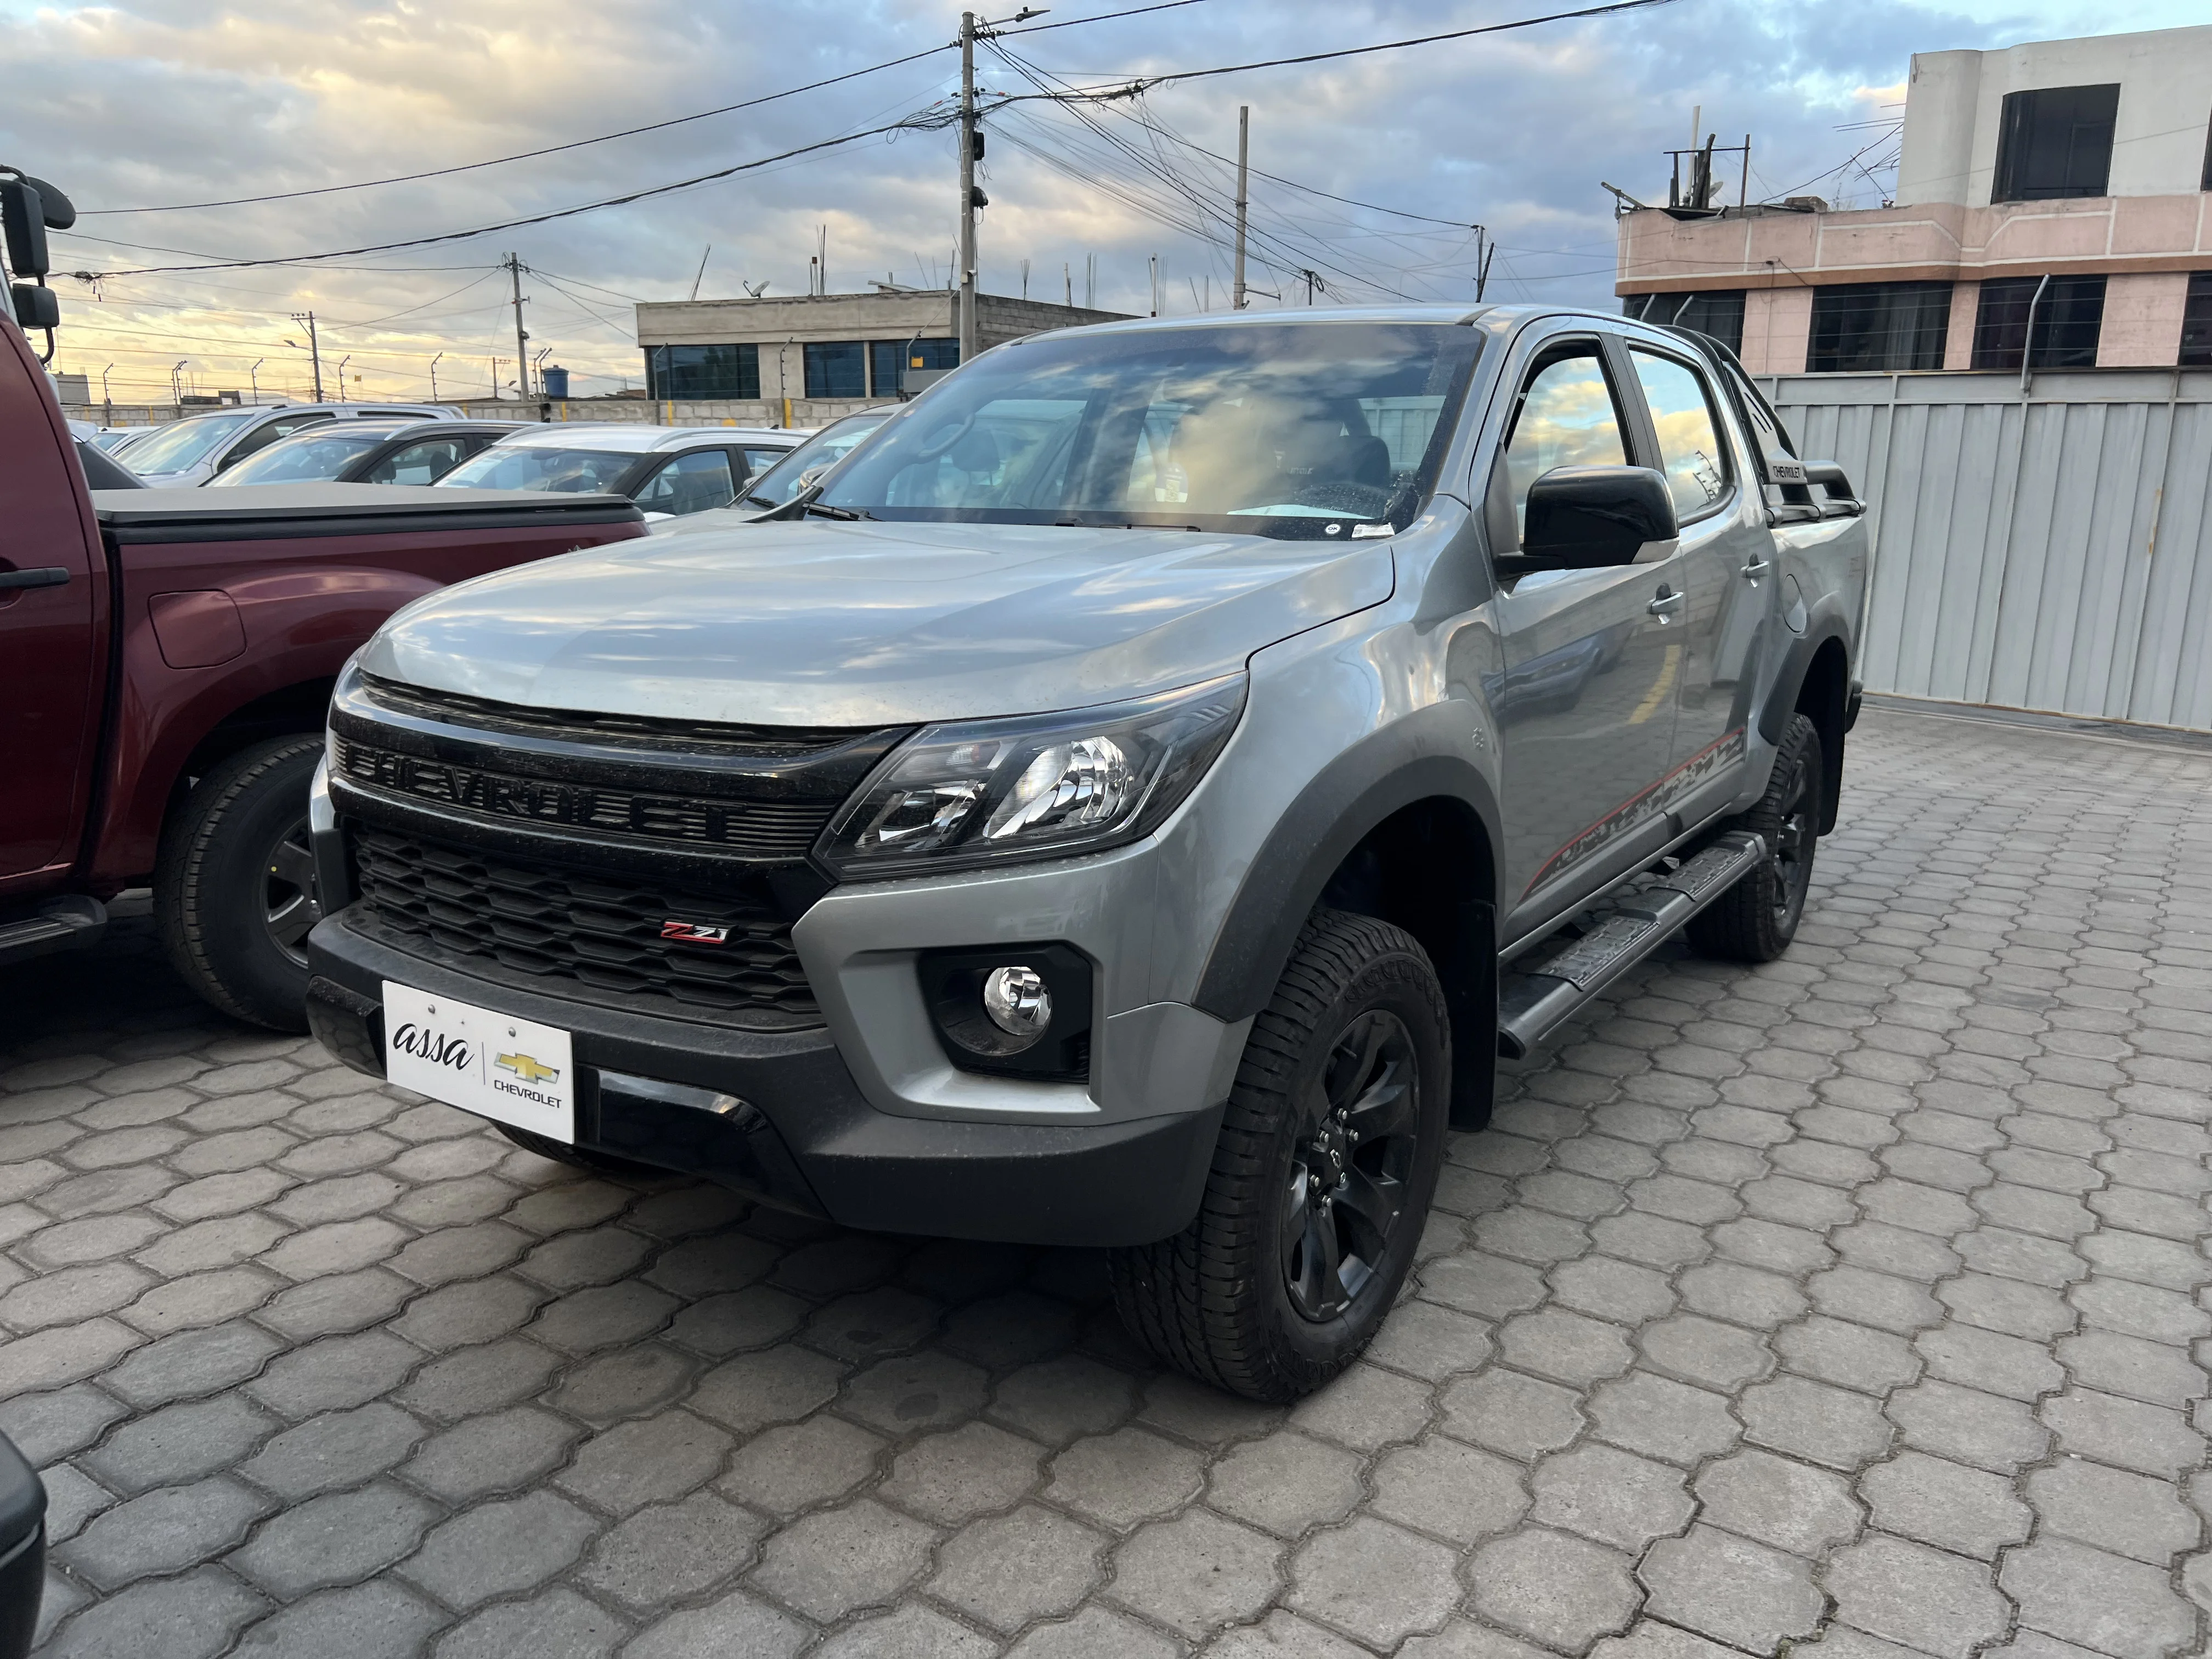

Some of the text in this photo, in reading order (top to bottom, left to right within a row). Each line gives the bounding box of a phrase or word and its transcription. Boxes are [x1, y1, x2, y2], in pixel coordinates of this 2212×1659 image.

[345, 742, 748, 840] CHEVROLET
[661, 922, 729, 944] Z71
[393, 1023, 475, 1070] assa
[494, 1079, 562, 1109] CHEVROLET
